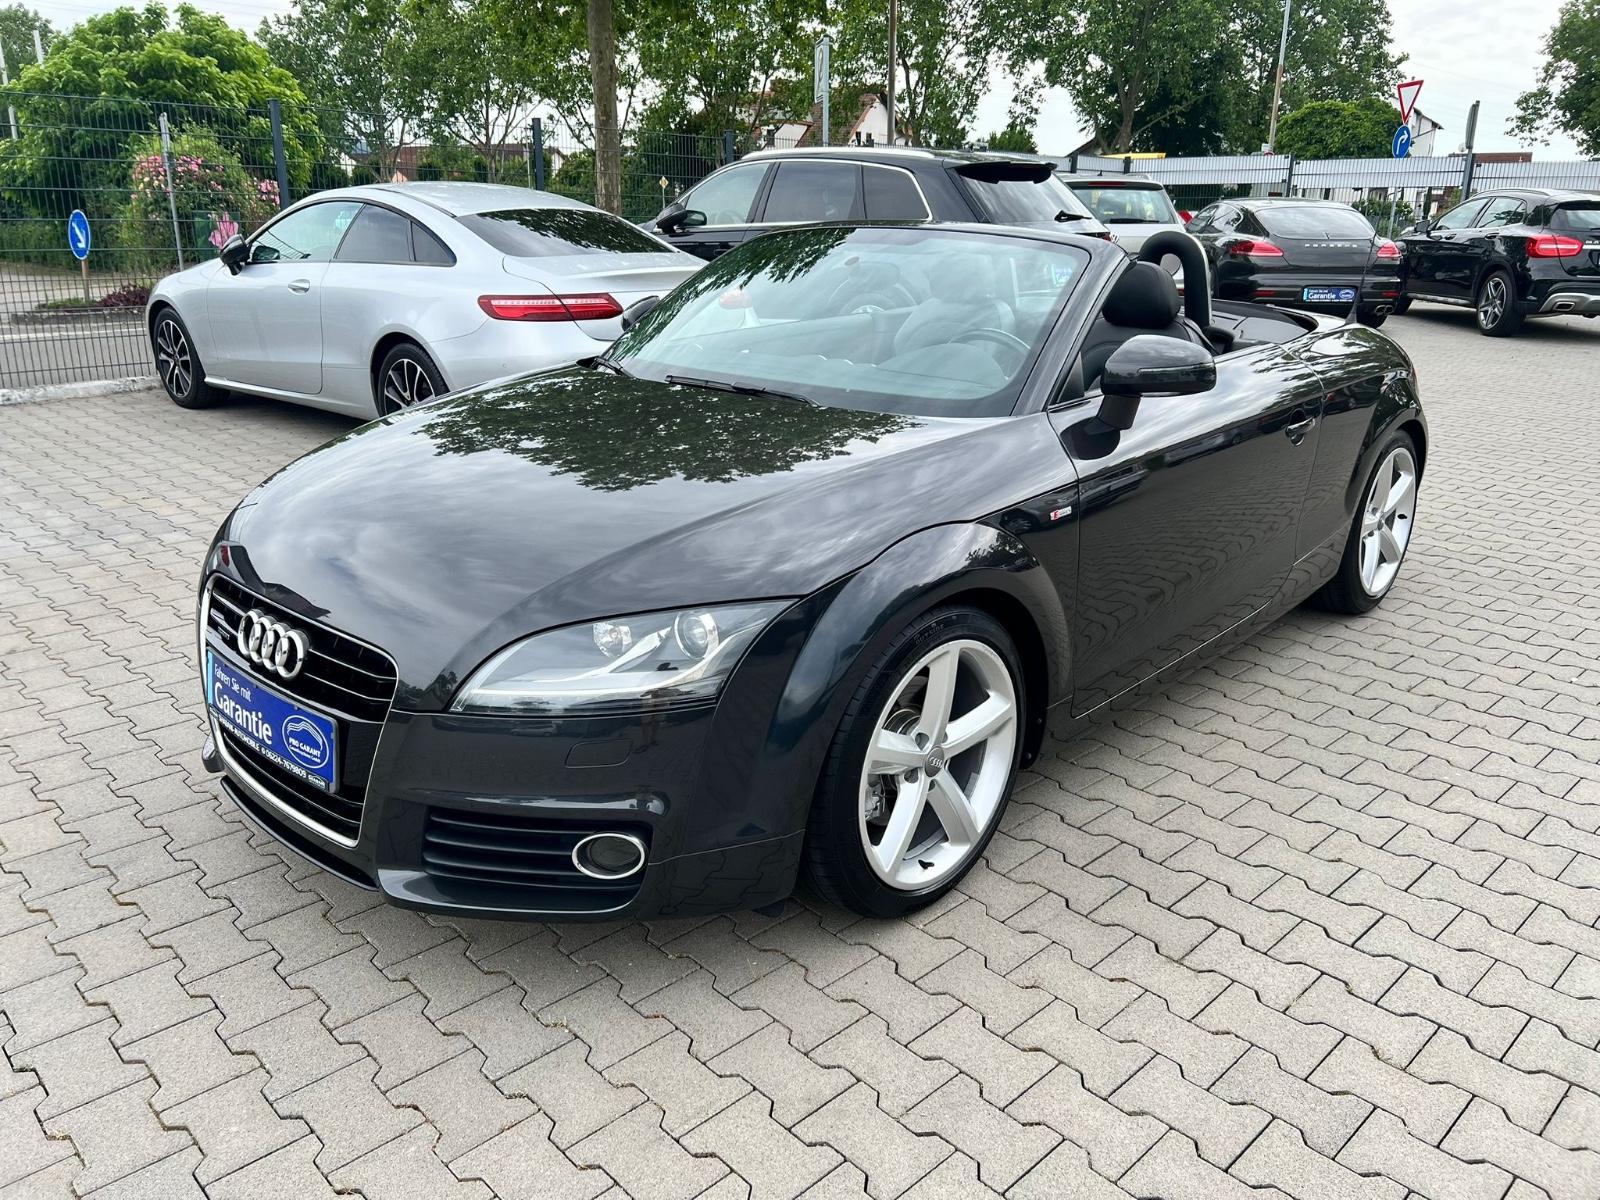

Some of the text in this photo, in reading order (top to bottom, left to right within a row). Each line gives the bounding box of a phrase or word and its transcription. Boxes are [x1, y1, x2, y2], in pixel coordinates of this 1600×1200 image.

[214, 663, 252, 702] Fahren Sie mit
[214, 681, 273, 745] Garantie
[289, 737, 300, 748] PRO
[299, 742, 321, 758] GARANT
